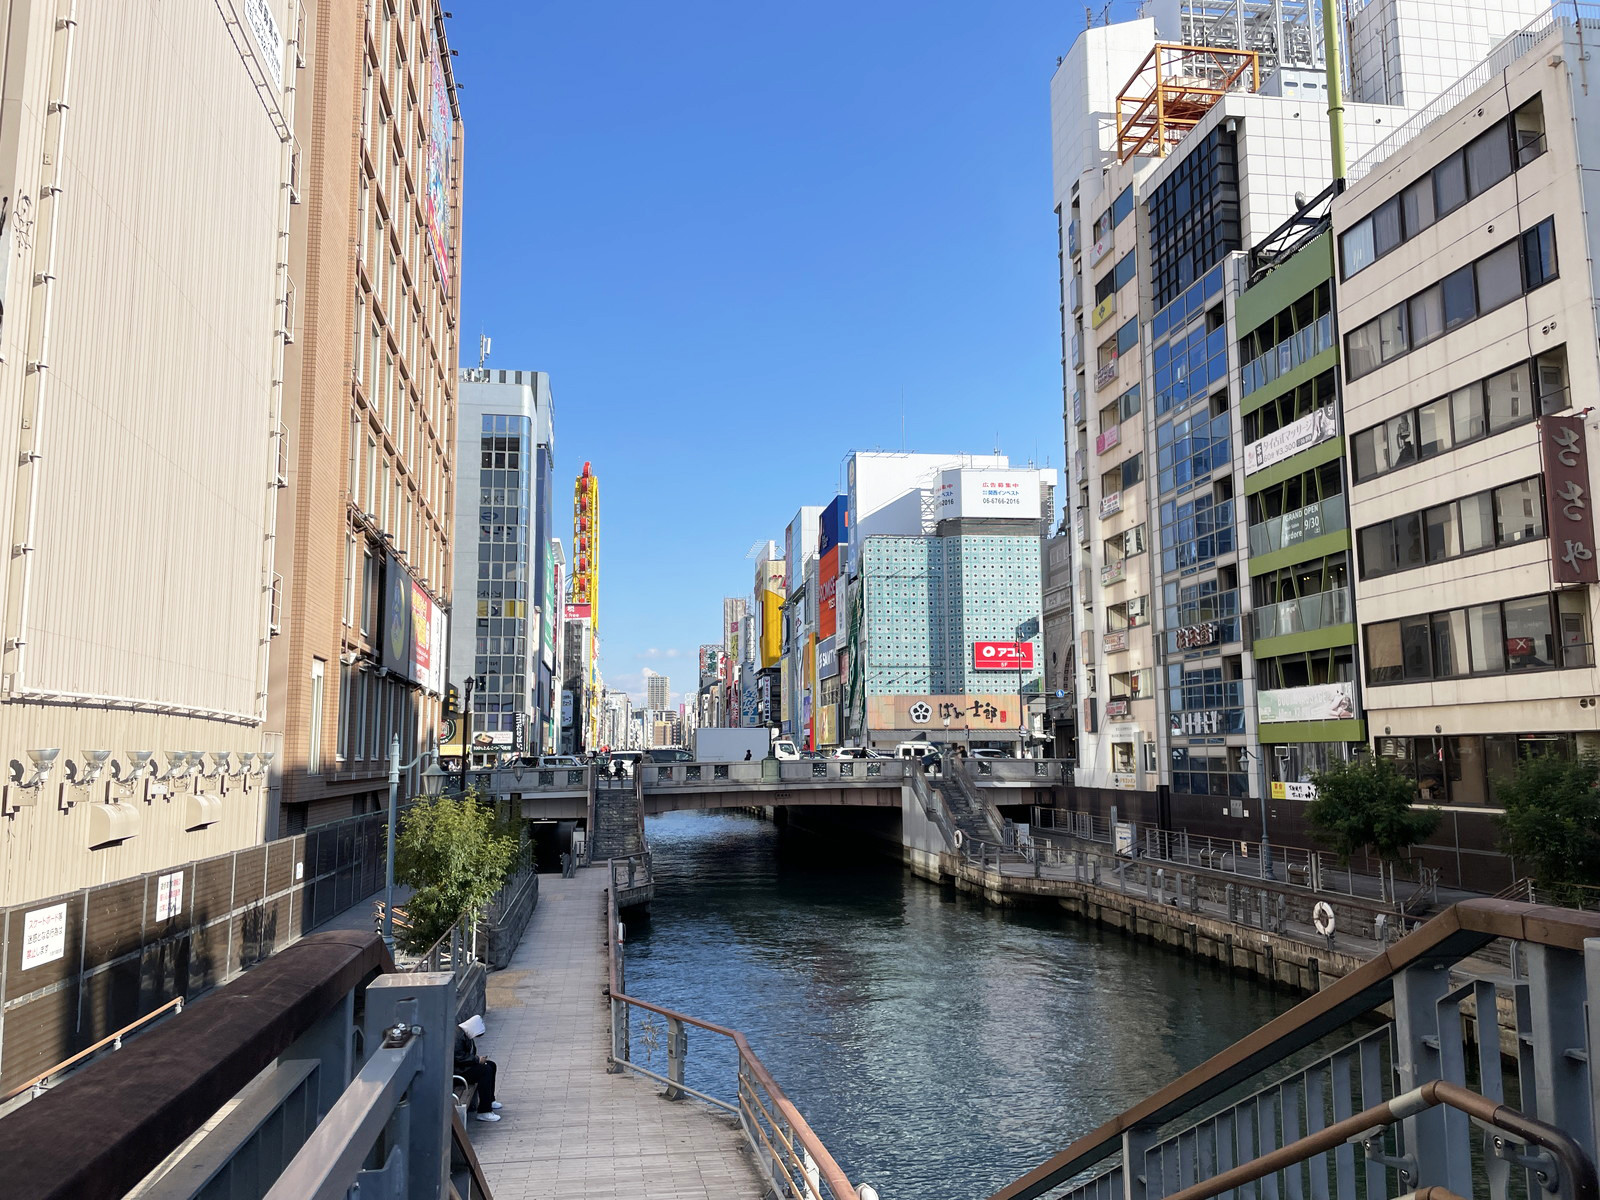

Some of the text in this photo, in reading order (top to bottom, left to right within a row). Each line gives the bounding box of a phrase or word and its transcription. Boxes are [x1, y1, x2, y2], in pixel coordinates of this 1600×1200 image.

[1552, 426, 1592, 574] ささや
[1304, 504, 1319, 515] OPEN
[1304, 515, 1320, 530] 9/30
[997, 647, 1027, 658] アコム
